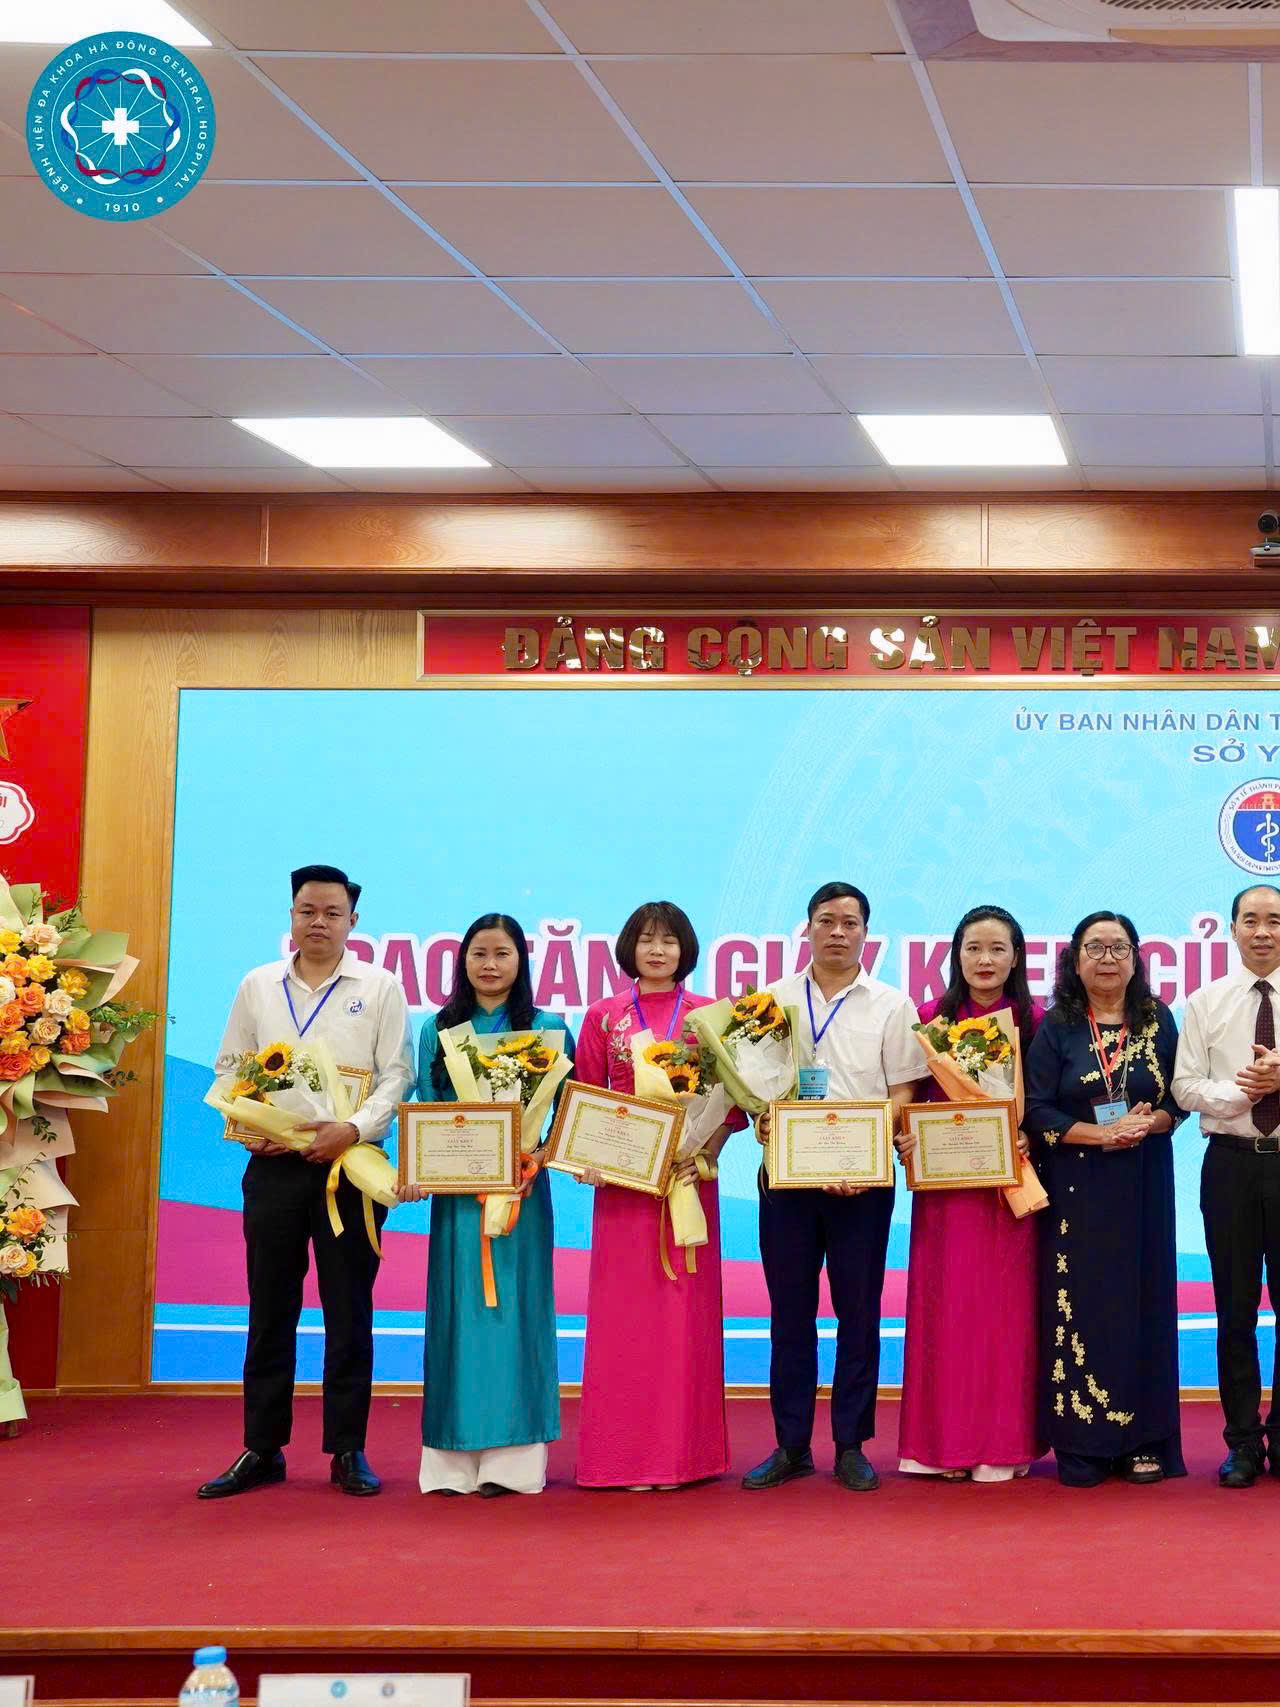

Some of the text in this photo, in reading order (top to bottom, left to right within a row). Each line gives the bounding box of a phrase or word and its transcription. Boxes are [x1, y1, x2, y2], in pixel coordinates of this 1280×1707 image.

[502, 616, 665, 670] ĐẢNG
[687, 617, 848, 676] CỘNG
[869, 616, 991, 670] SẢN
[1011, 618, 1137, 676] VIỆT
[1015, 706, 1049, 731] ỦY
[1059, 713, 1113, 731] BAN
[1123, 709, 1196, 731] NHÂN
[1206, 709, 1260, 731] DÂN
[1193, 738, 1245, 762] SỞ
[1258, 745, 1280, 762] Y
